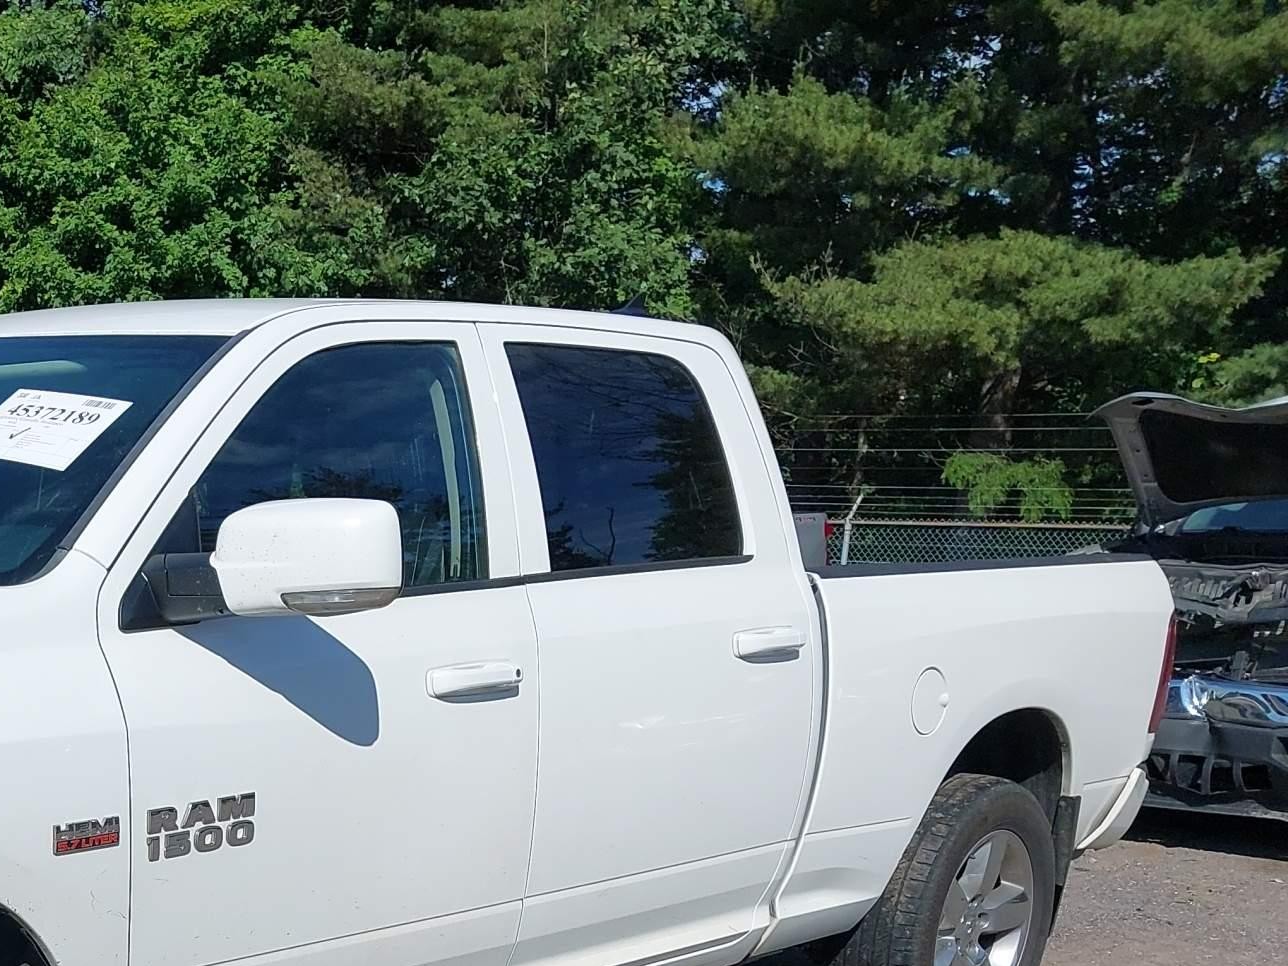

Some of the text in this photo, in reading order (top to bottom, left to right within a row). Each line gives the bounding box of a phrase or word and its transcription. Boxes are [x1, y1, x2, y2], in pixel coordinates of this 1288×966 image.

[8, 403, 101, 425] 45372189
[53, 816, 120, 840] HEMI
[146, 792, 256, 835] RAM
[146, 819, 255, 862] 1500
